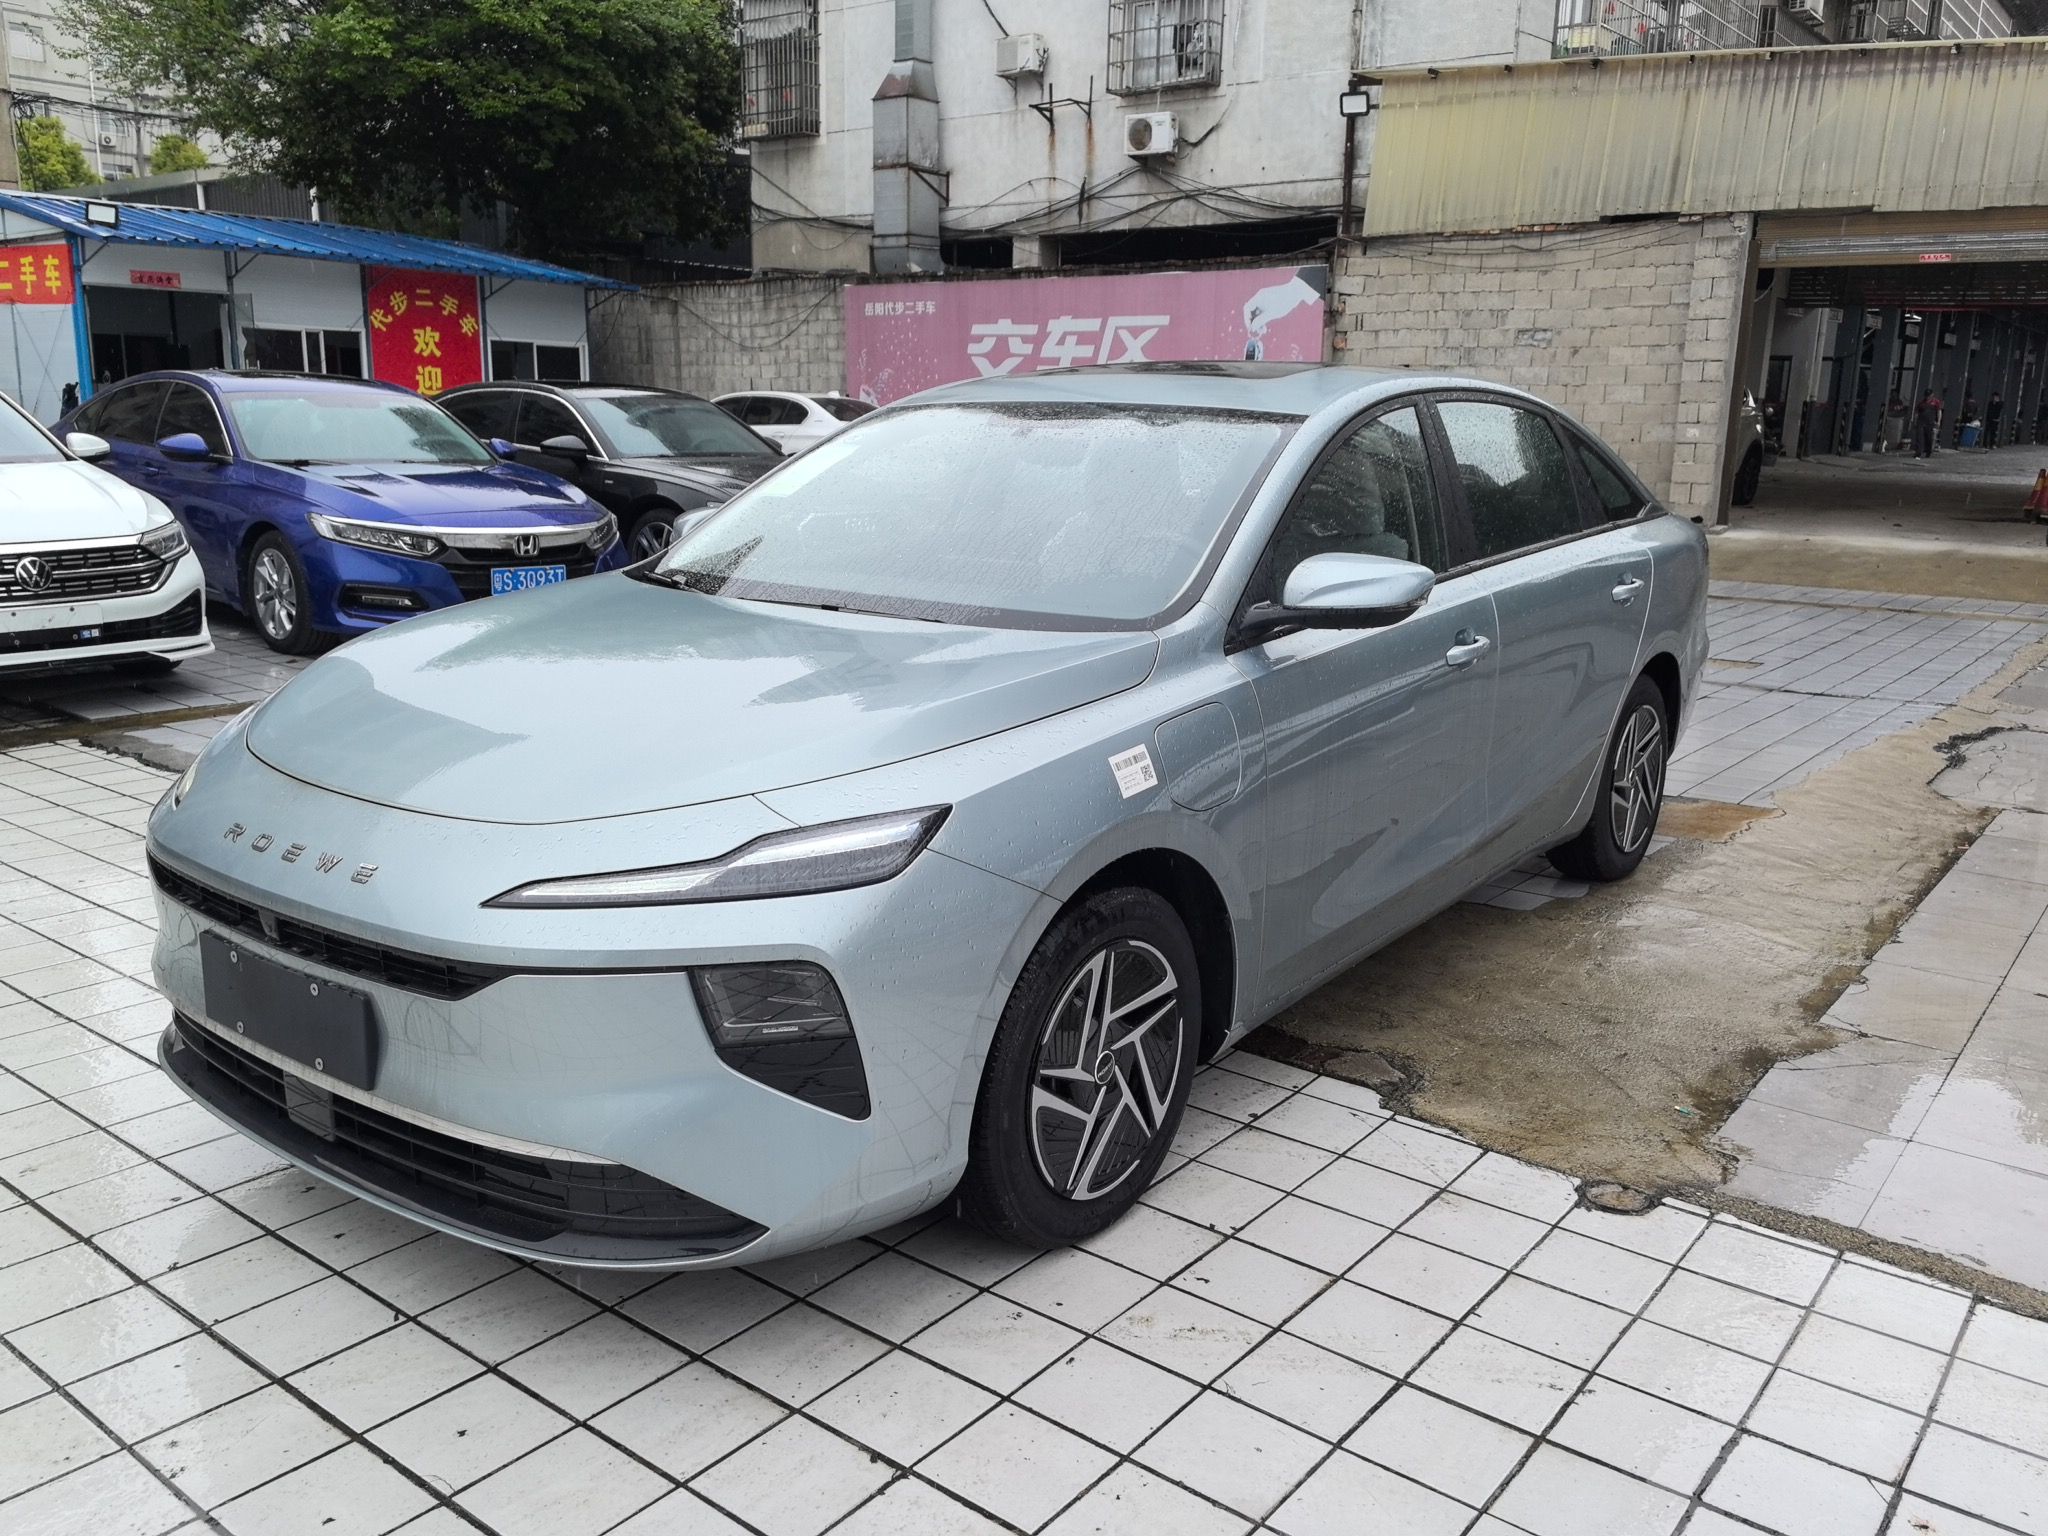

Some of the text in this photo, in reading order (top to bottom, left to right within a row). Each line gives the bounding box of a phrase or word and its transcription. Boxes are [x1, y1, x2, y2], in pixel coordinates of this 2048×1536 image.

[0, 254, 62, 296] 二手车
[370, 288, 479, 337] 代步二手车
[864, 300, 937, 317] 岳阳代步二手车
[413, 326, 442, 396] 欢迎
[966, 315, 1170, 379] 交车区
[223, 822, 379, 884] ROEWE
